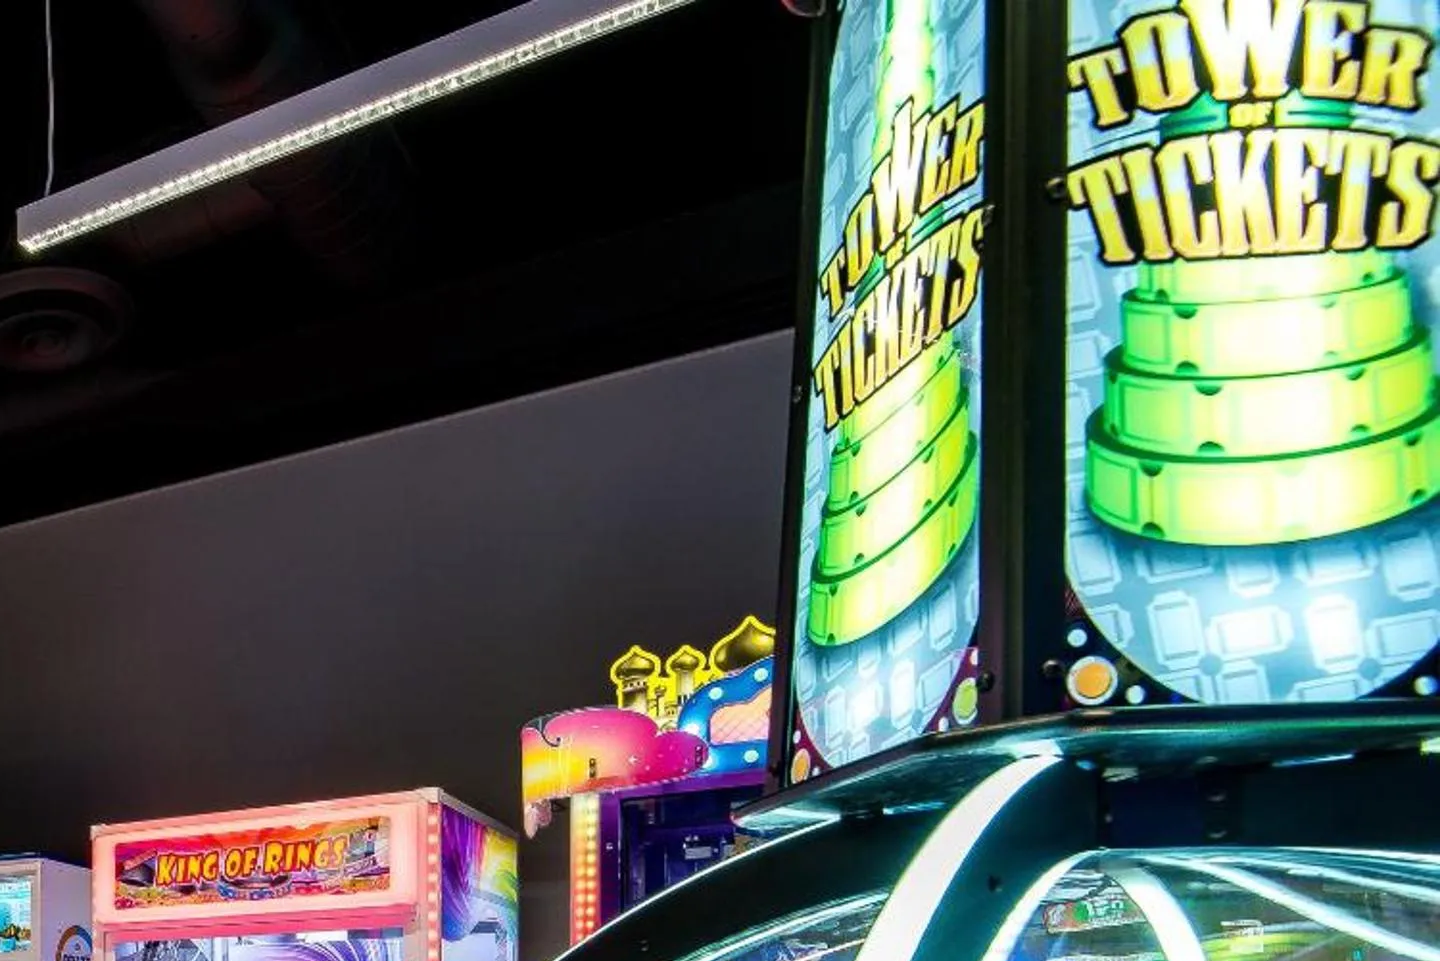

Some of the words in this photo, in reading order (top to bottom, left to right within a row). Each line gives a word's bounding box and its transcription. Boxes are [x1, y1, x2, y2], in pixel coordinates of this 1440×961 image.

[1069, 0, 1432, 129] TOWER
[819, 94, 985, 321] TOWER
[1068, 126, 1440, 268] TICKETS
[813, 205, 987, 433] TICKETS
[155, 849, 218, 885] KING
[225, 847, 259, 878] OF
[264, 835, 350, 873] RINGS
